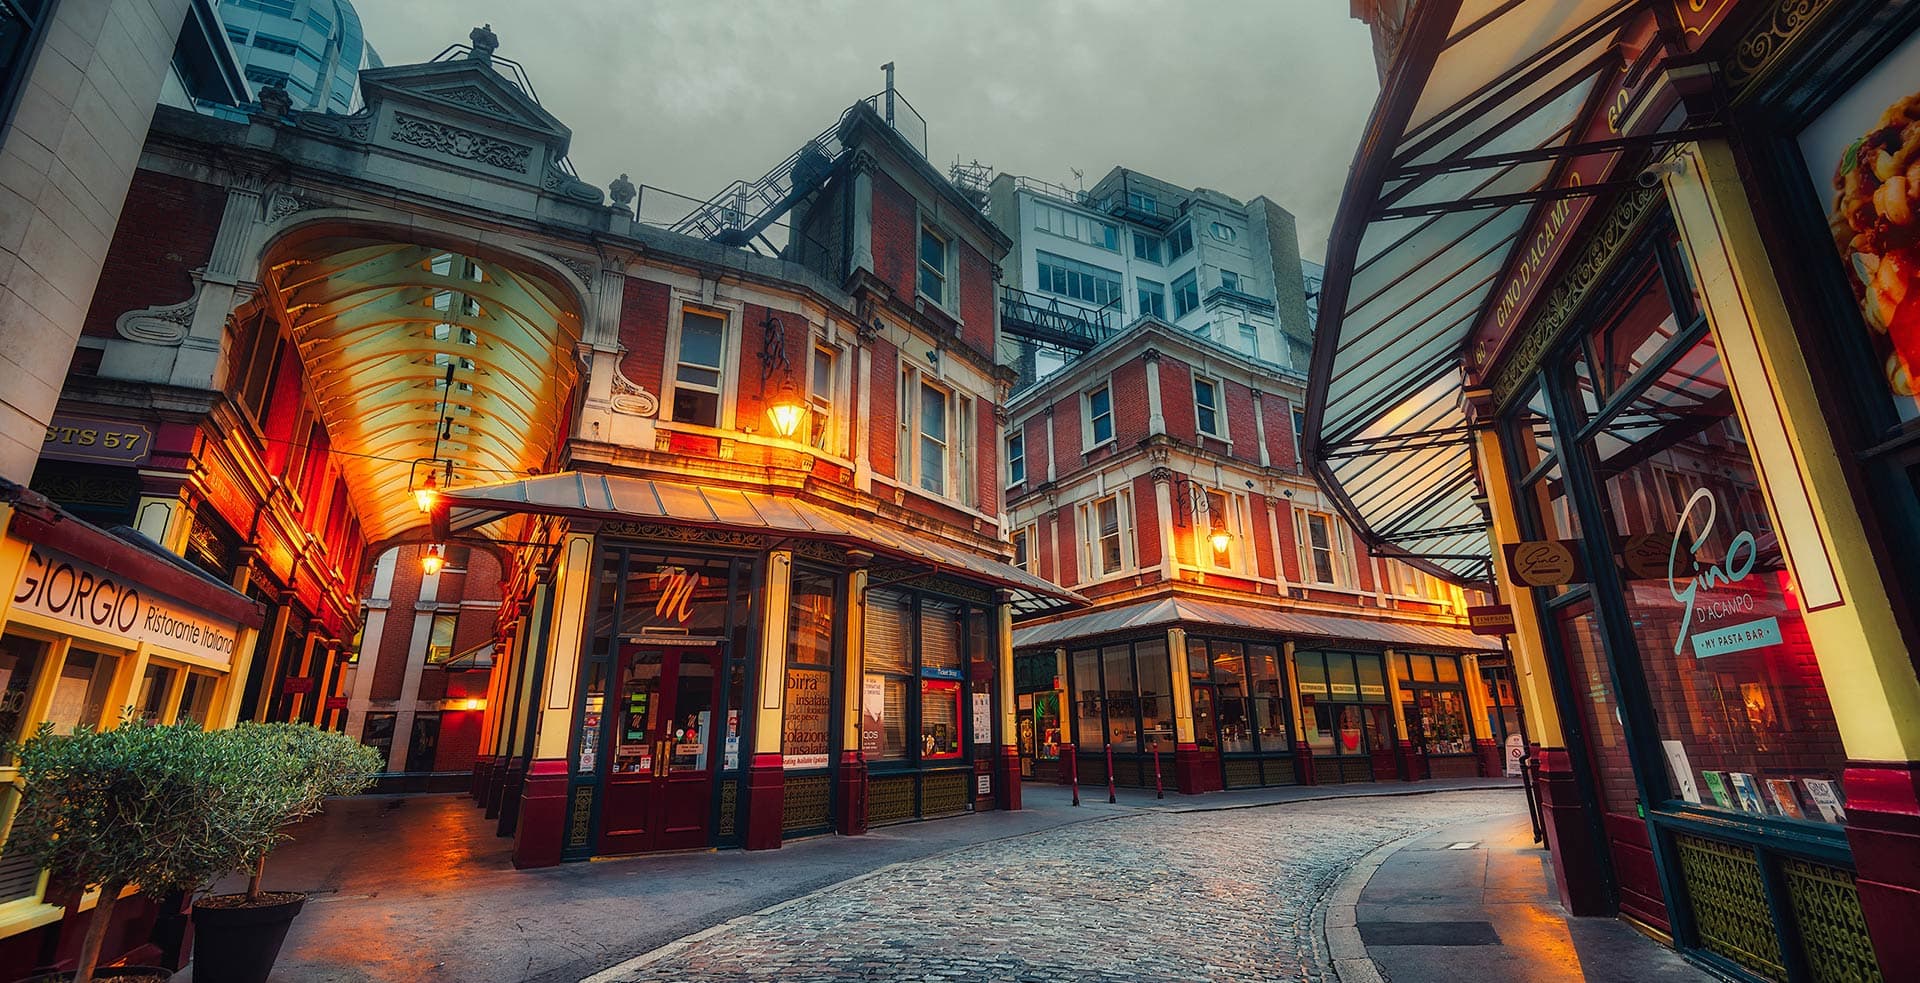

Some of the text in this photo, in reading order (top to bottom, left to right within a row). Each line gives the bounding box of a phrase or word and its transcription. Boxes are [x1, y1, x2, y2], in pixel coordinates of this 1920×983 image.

[1475, 341, 1486, 365] 60
[1496, 279, 1521, 328] GINO
[103, 432, 141, 450] 57
[1522, 546, 1560, 574] Gino
[1668, 487, 1757, 656] Gino
[14, 550, 234, 654] GIORGIO Ristorante Italiano
[656, 566, 700, 624] M
[1696, 593, 1754, 623] D'ACAMPO
[1704, 628, 1764, 649] MY PASTA BAR
[787, 672, 818, 690] birra
[796, 694, 829, 706] insalata
[784, 729, 829, 743] colazione
[863, 731, 878, 740] QOS
[790, 743, 828, 755] insalata
